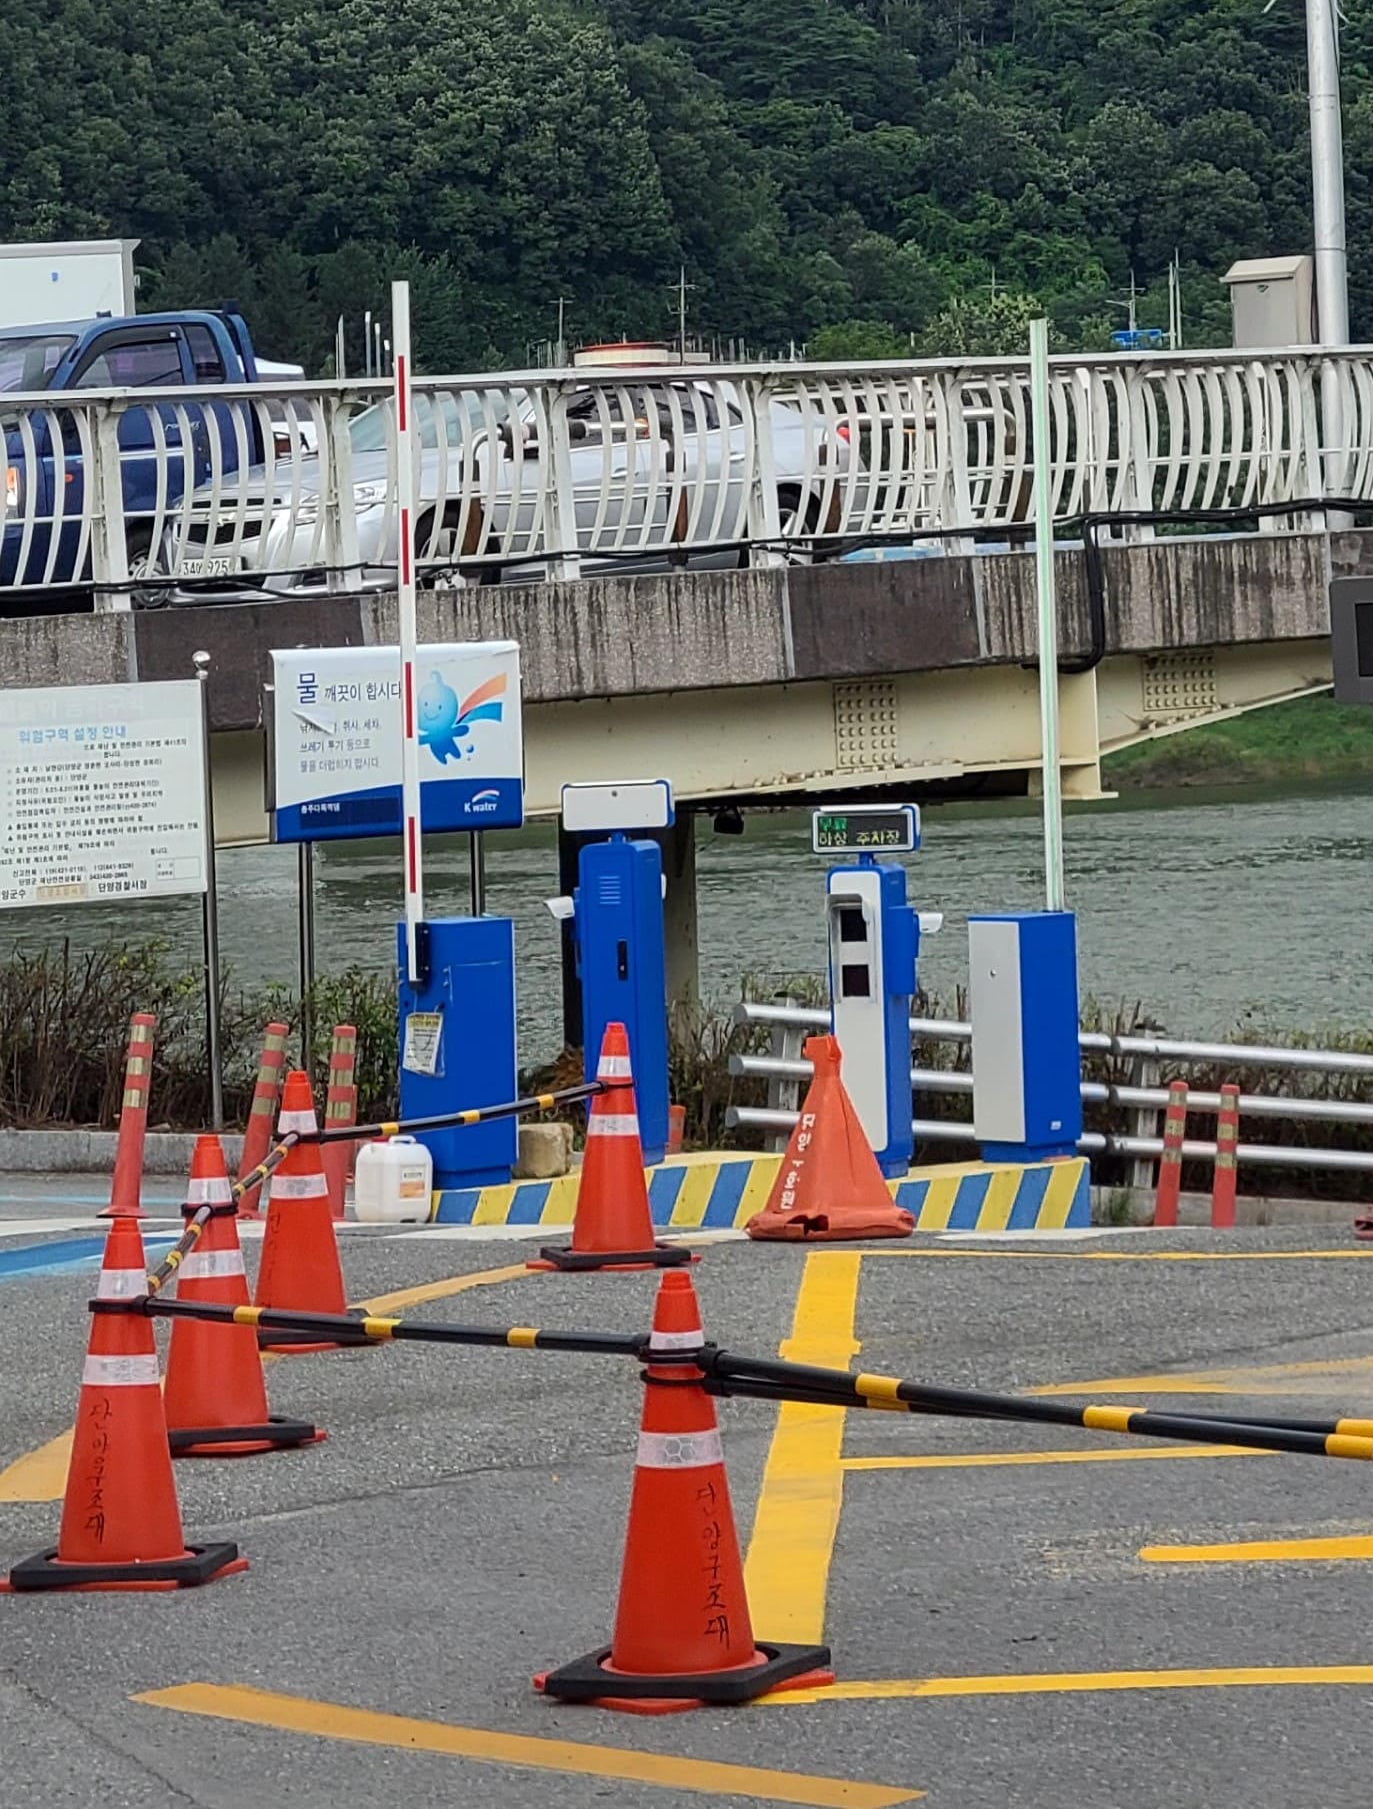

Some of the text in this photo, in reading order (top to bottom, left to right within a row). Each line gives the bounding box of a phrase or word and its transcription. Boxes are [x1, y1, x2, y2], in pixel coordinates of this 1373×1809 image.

[297, 672, 319, 704] 물
[324, 683, 362, 703] 깨끗이
[102, 724, 127, 739] 안내
